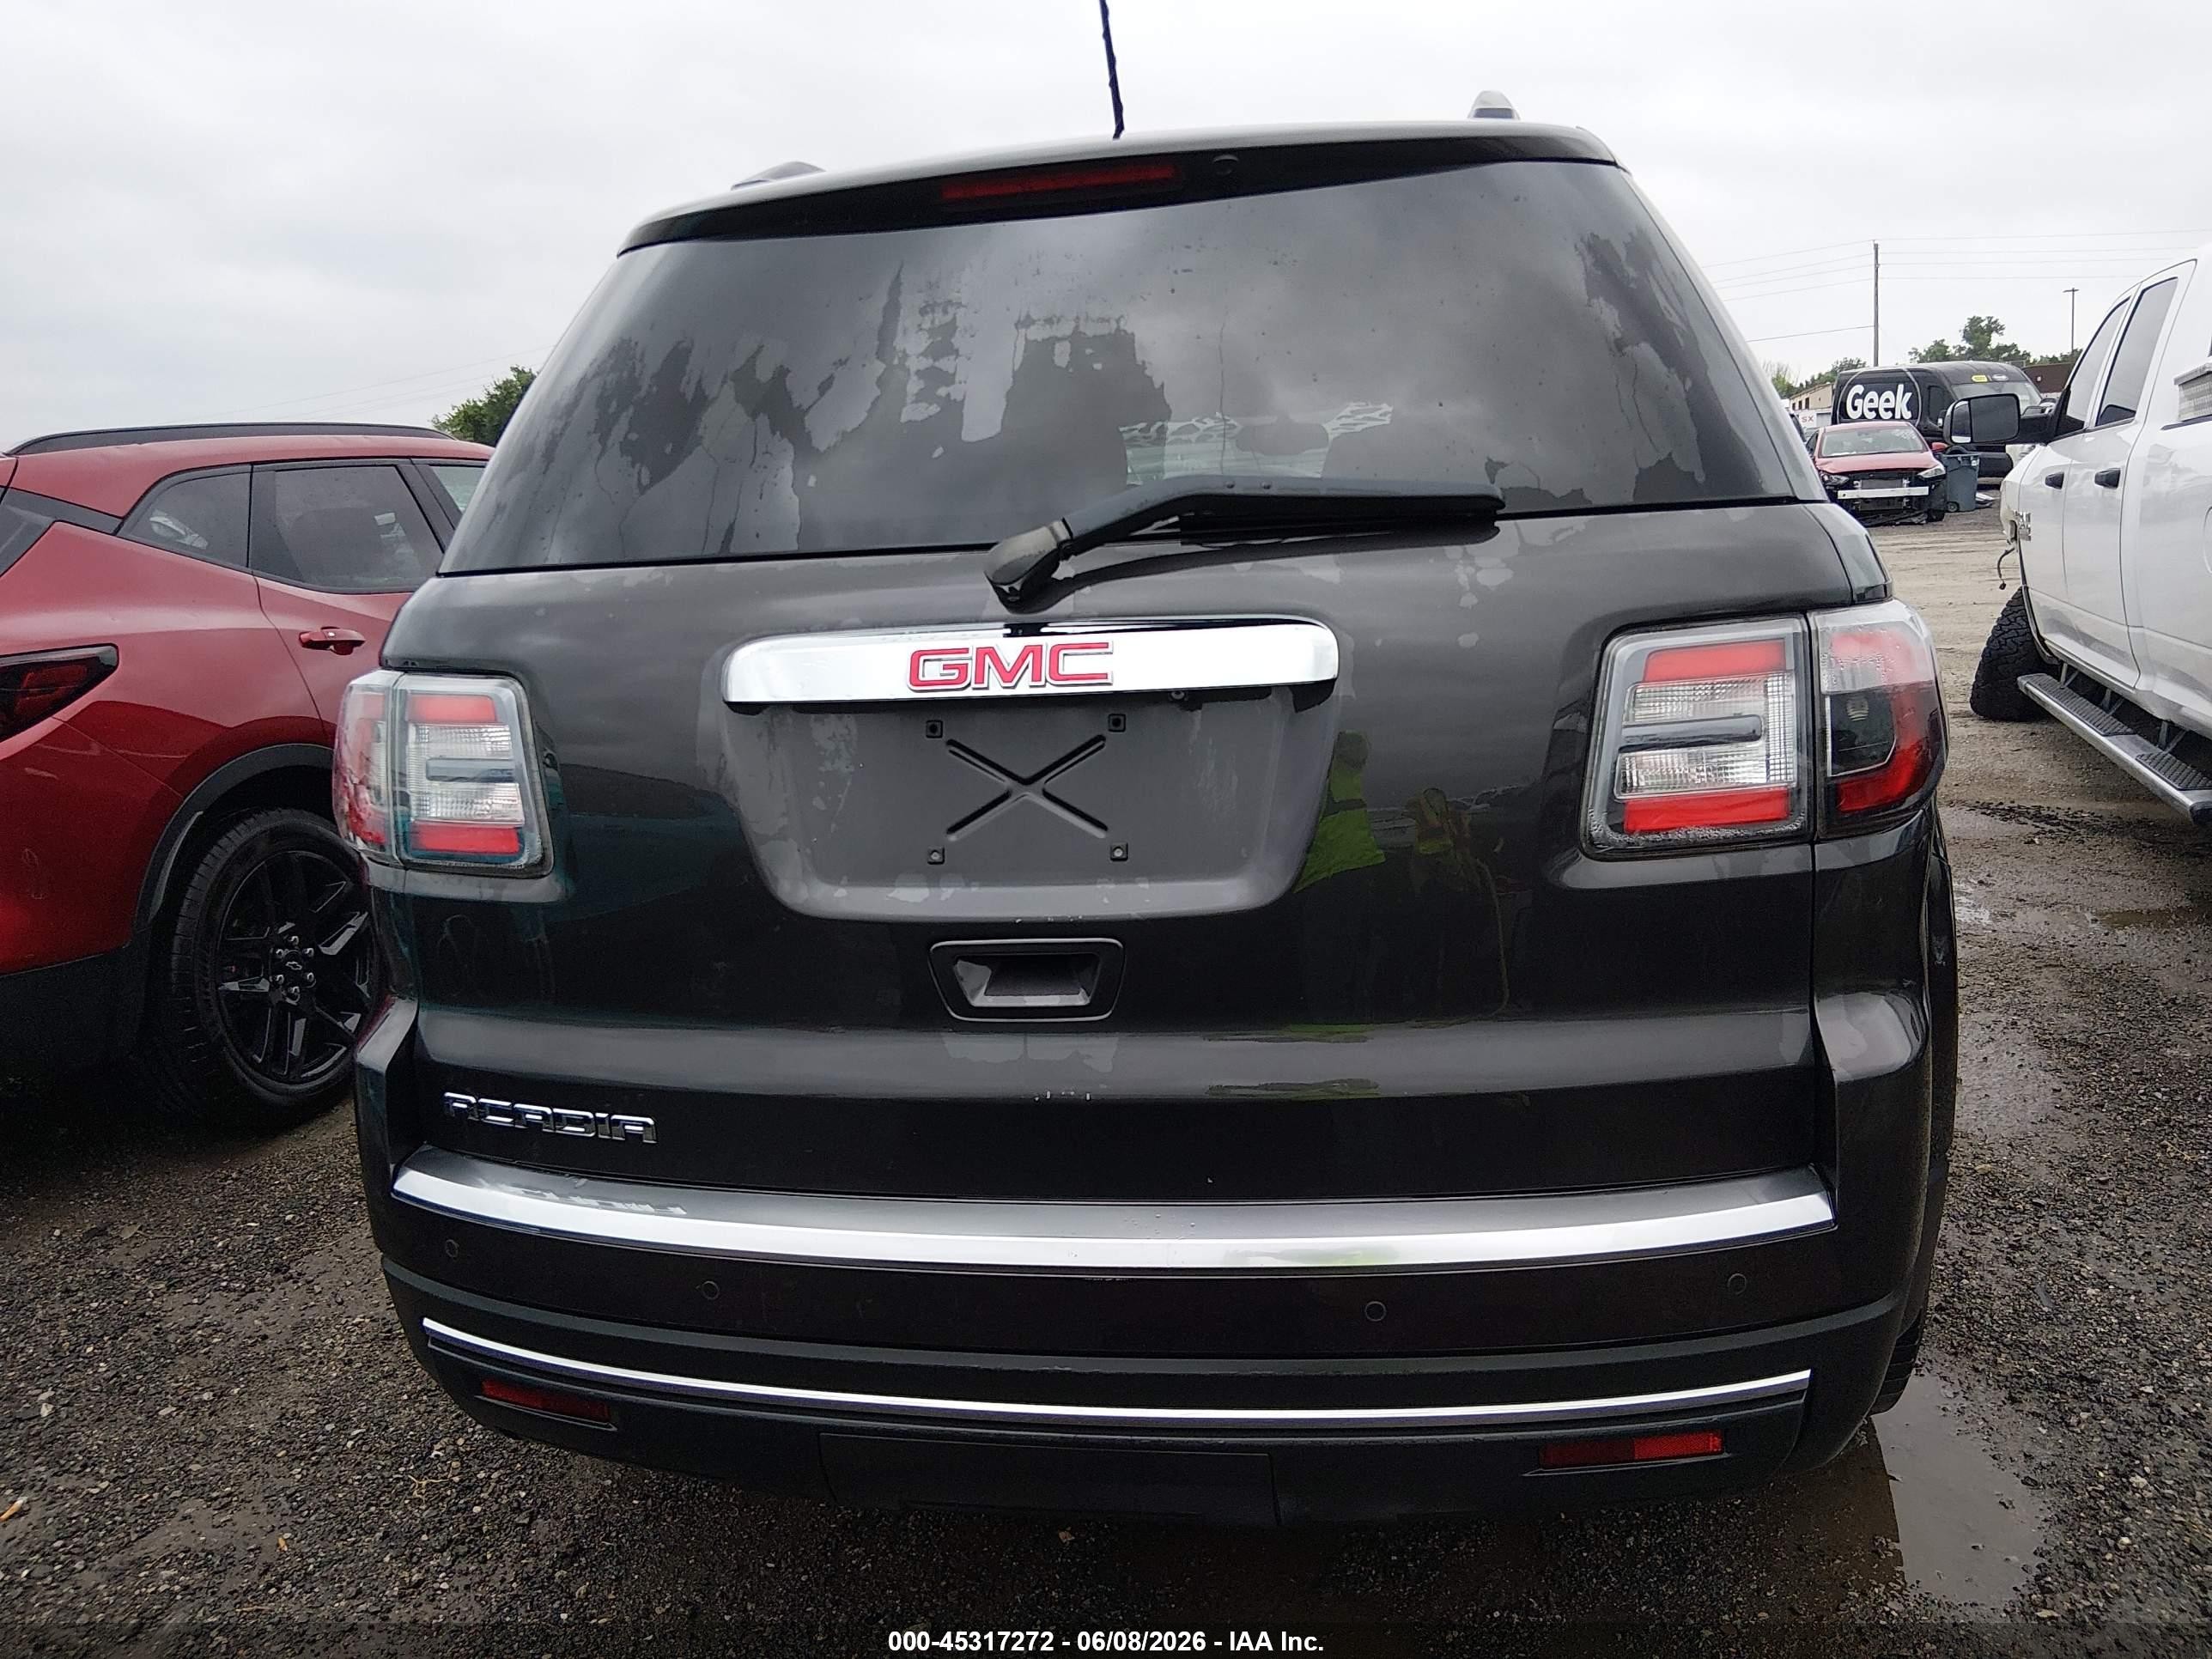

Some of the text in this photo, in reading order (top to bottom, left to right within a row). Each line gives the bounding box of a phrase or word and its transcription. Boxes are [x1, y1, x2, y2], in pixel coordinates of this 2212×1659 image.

[1846, 384, 1912, 419] Geek
[908, 641, 1113, 692] GMC
[444, 1091, 657, 1143] ACADIA
